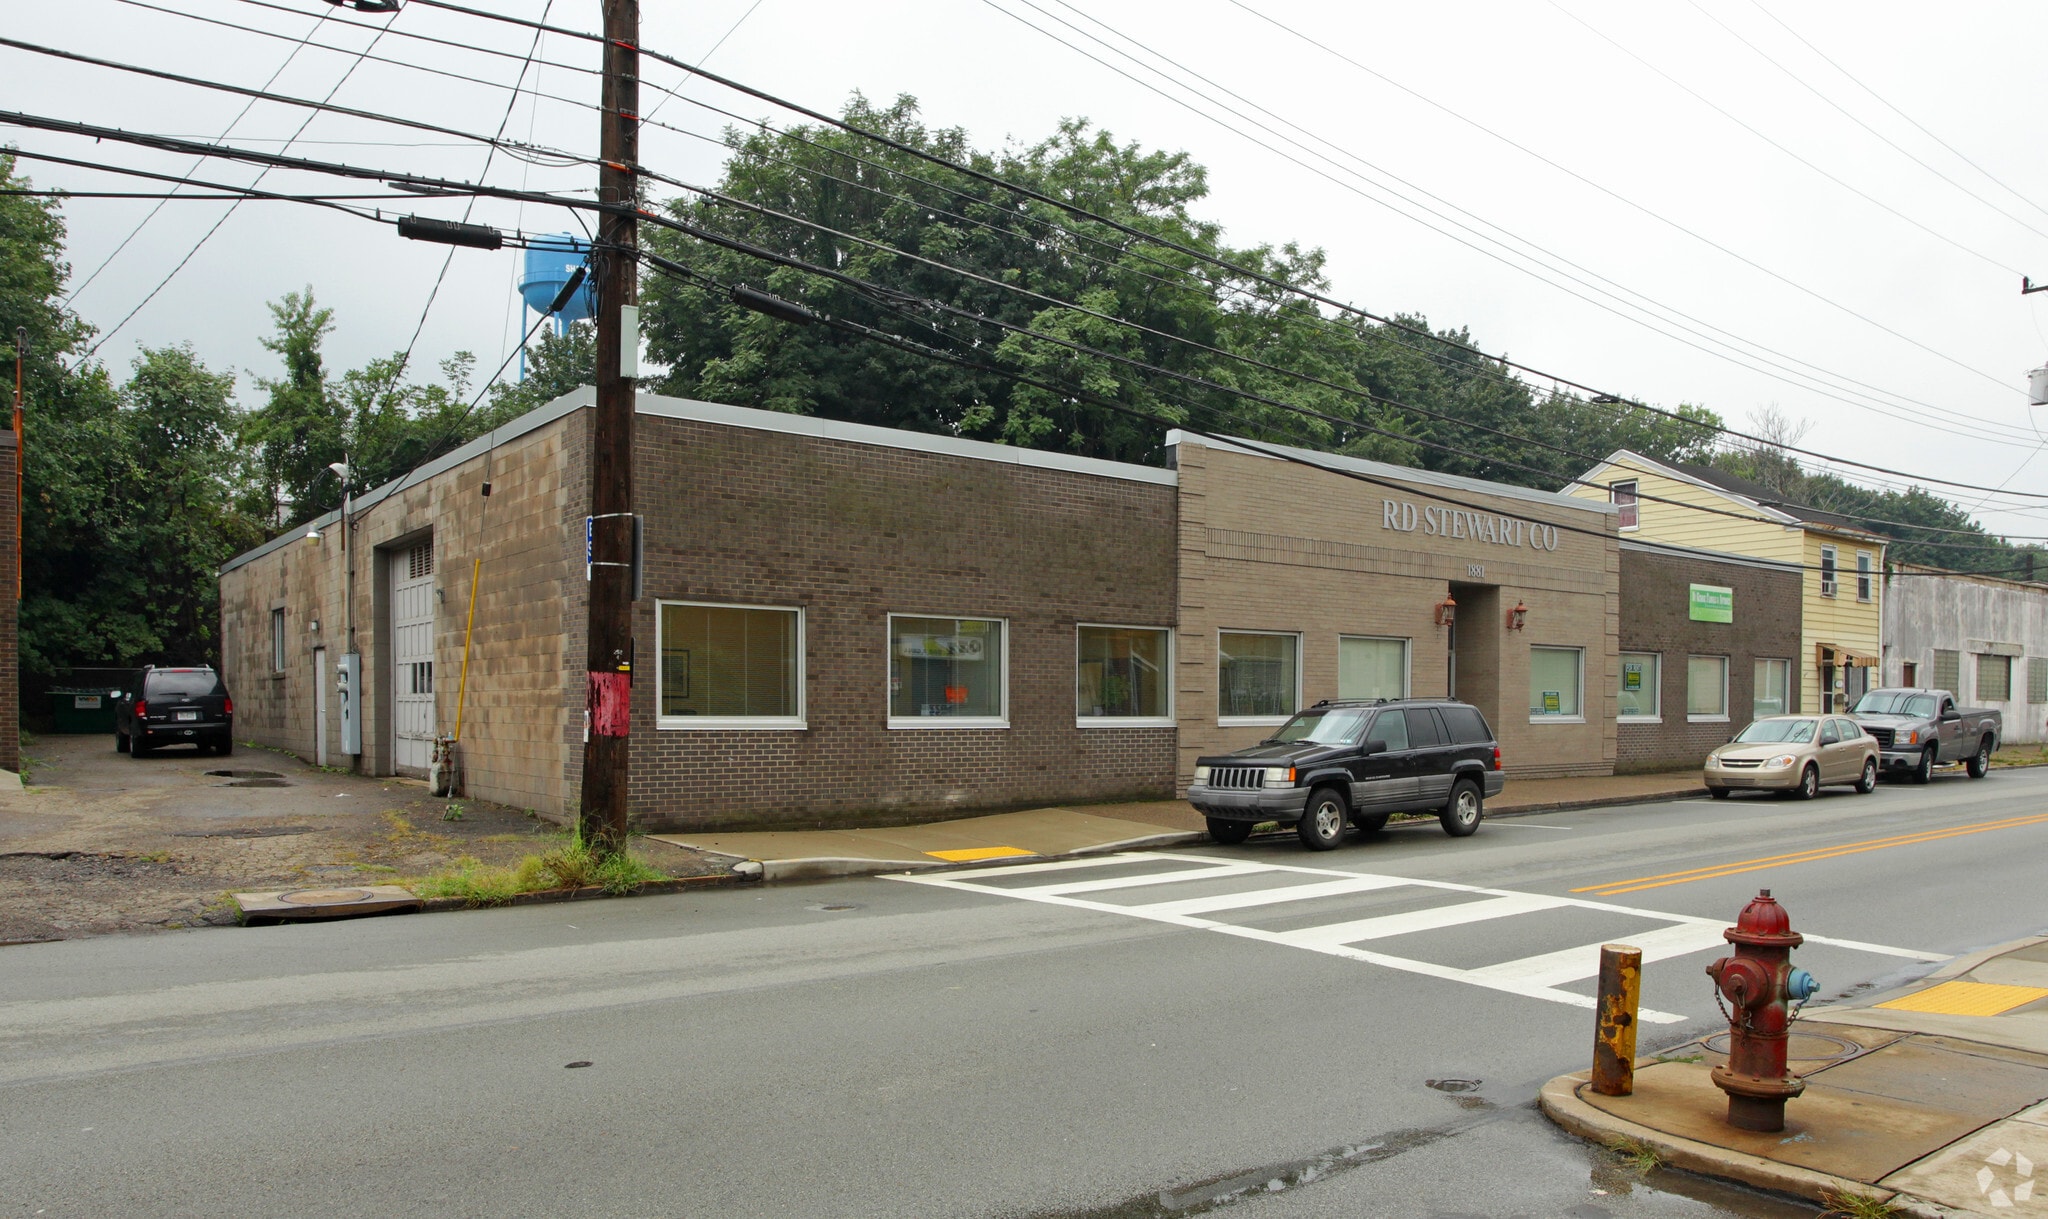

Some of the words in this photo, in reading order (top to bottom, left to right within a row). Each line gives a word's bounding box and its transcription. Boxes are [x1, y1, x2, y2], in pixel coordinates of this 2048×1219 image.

[1382, 500, 1418, 532] RD
[1424, 505, 1525, 547] STEWART
[1529, 523, 1558, 551] CO
[1467, 564, 1485, 578] 1881
